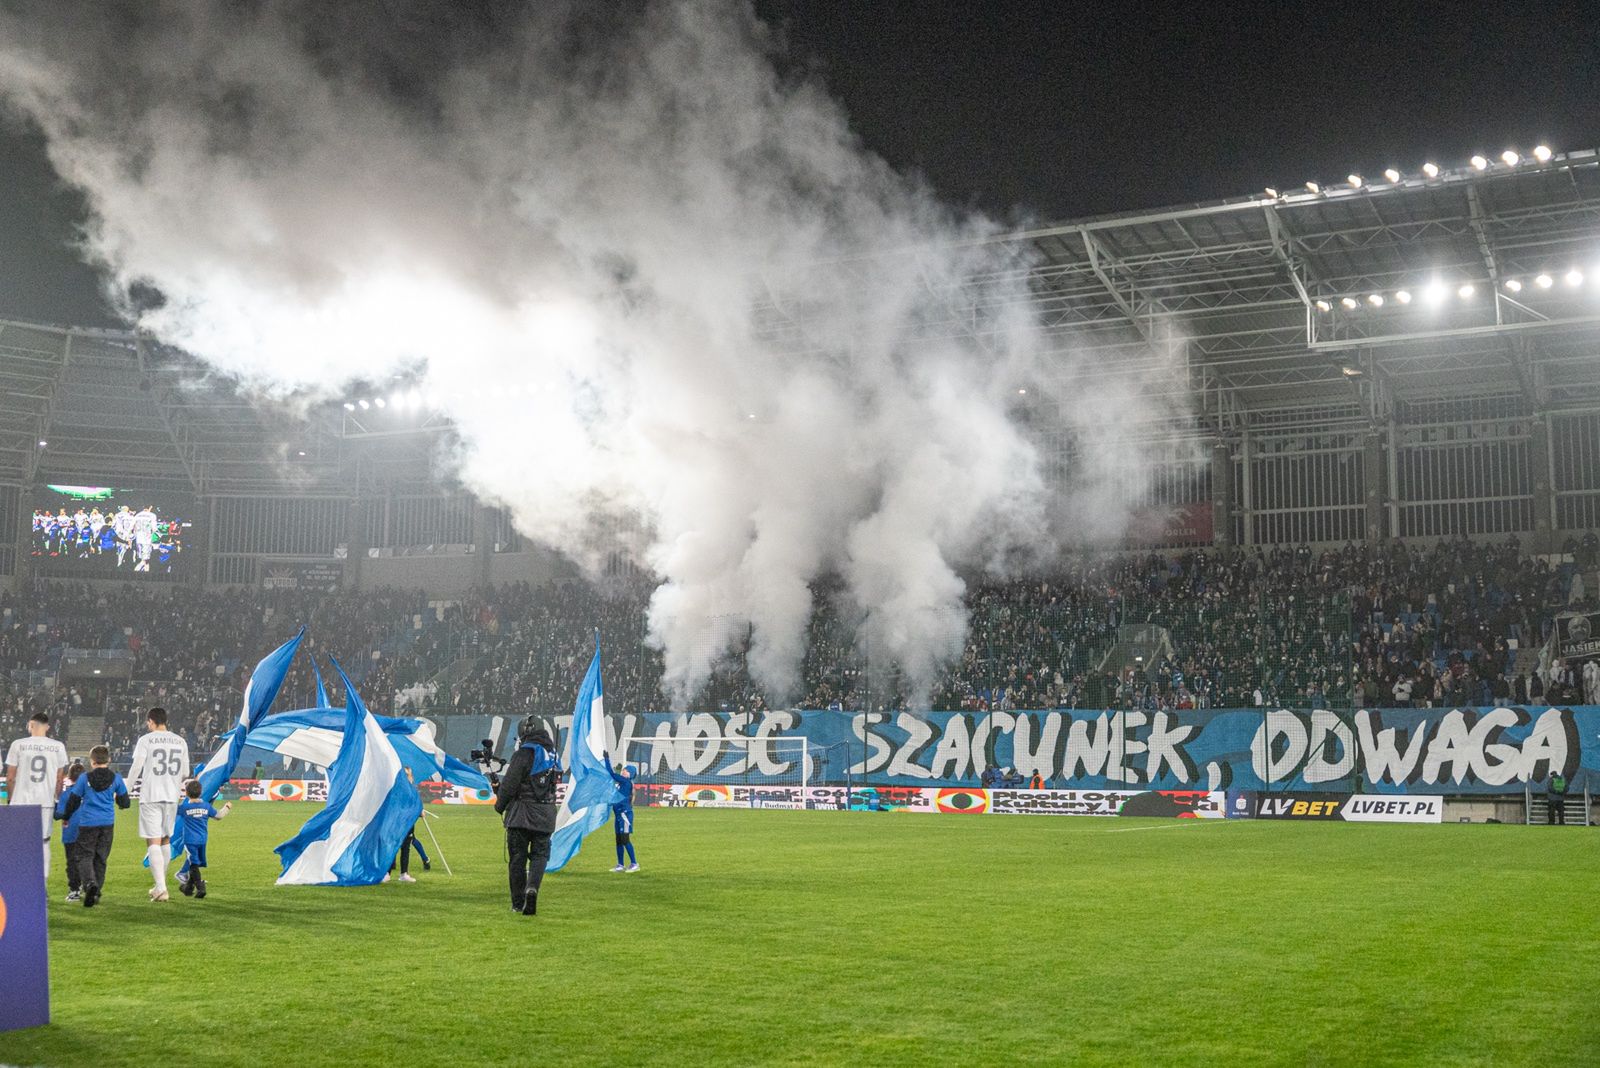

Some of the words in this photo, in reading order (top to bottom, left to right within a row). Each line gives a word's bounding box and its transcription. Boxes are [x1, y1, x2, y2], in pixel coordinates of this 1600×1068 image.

[1251, 708, 1567, 787] ODWAGA
[30, 755, 47, 783] 9
[152, 748, 182, 777] 35
[993, 800, 1103, 812] Kultury
[1351, 800, 1436, 816] LVBET.PL
